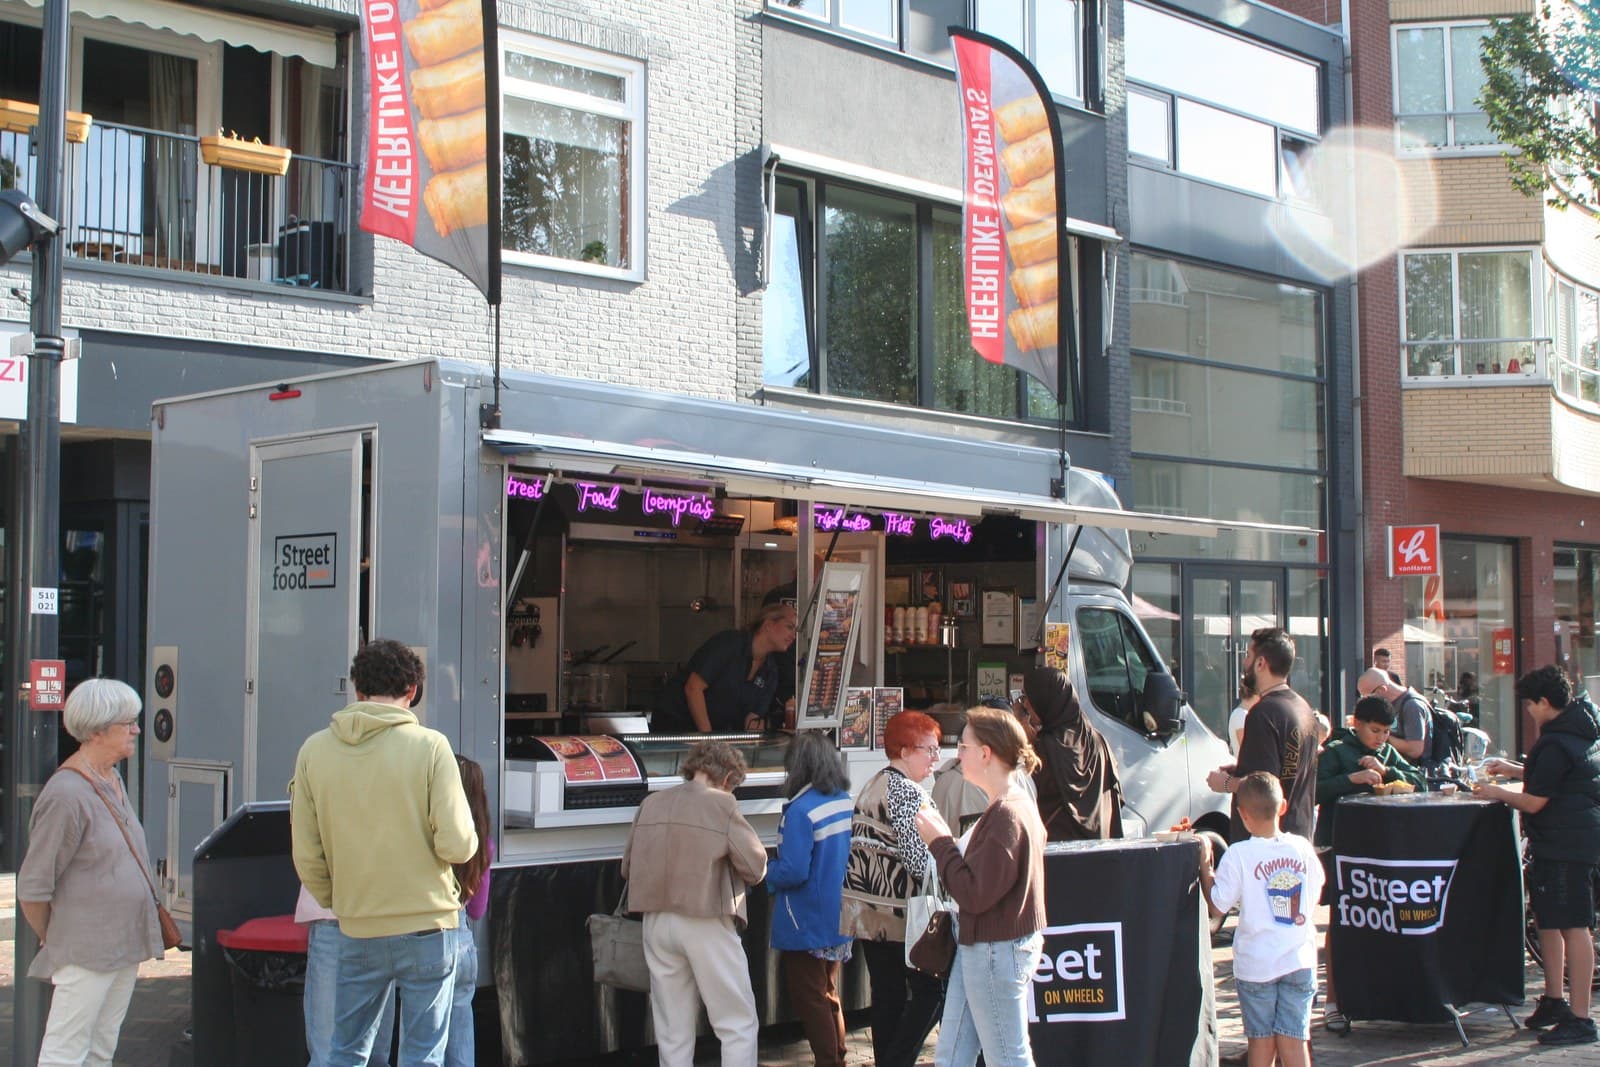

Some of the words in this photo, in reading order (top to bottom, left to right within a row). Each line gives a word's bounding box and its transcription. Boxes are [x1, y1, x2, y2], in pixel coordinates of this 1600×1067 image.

[507, 475, 543, 499] treet
[577, 483, 620, 511] Food
[282, 544, 330, 567] Street
[273, 565, 307, 591] food
[1350, 869, 1446, 904] Street
[1338, 894, 1398, 934] food
[1032, 943, 1102, 983] eet
[1044, 990, 1060, 1005] ON
[1063, 988, 1104, 1004] WHEELS
